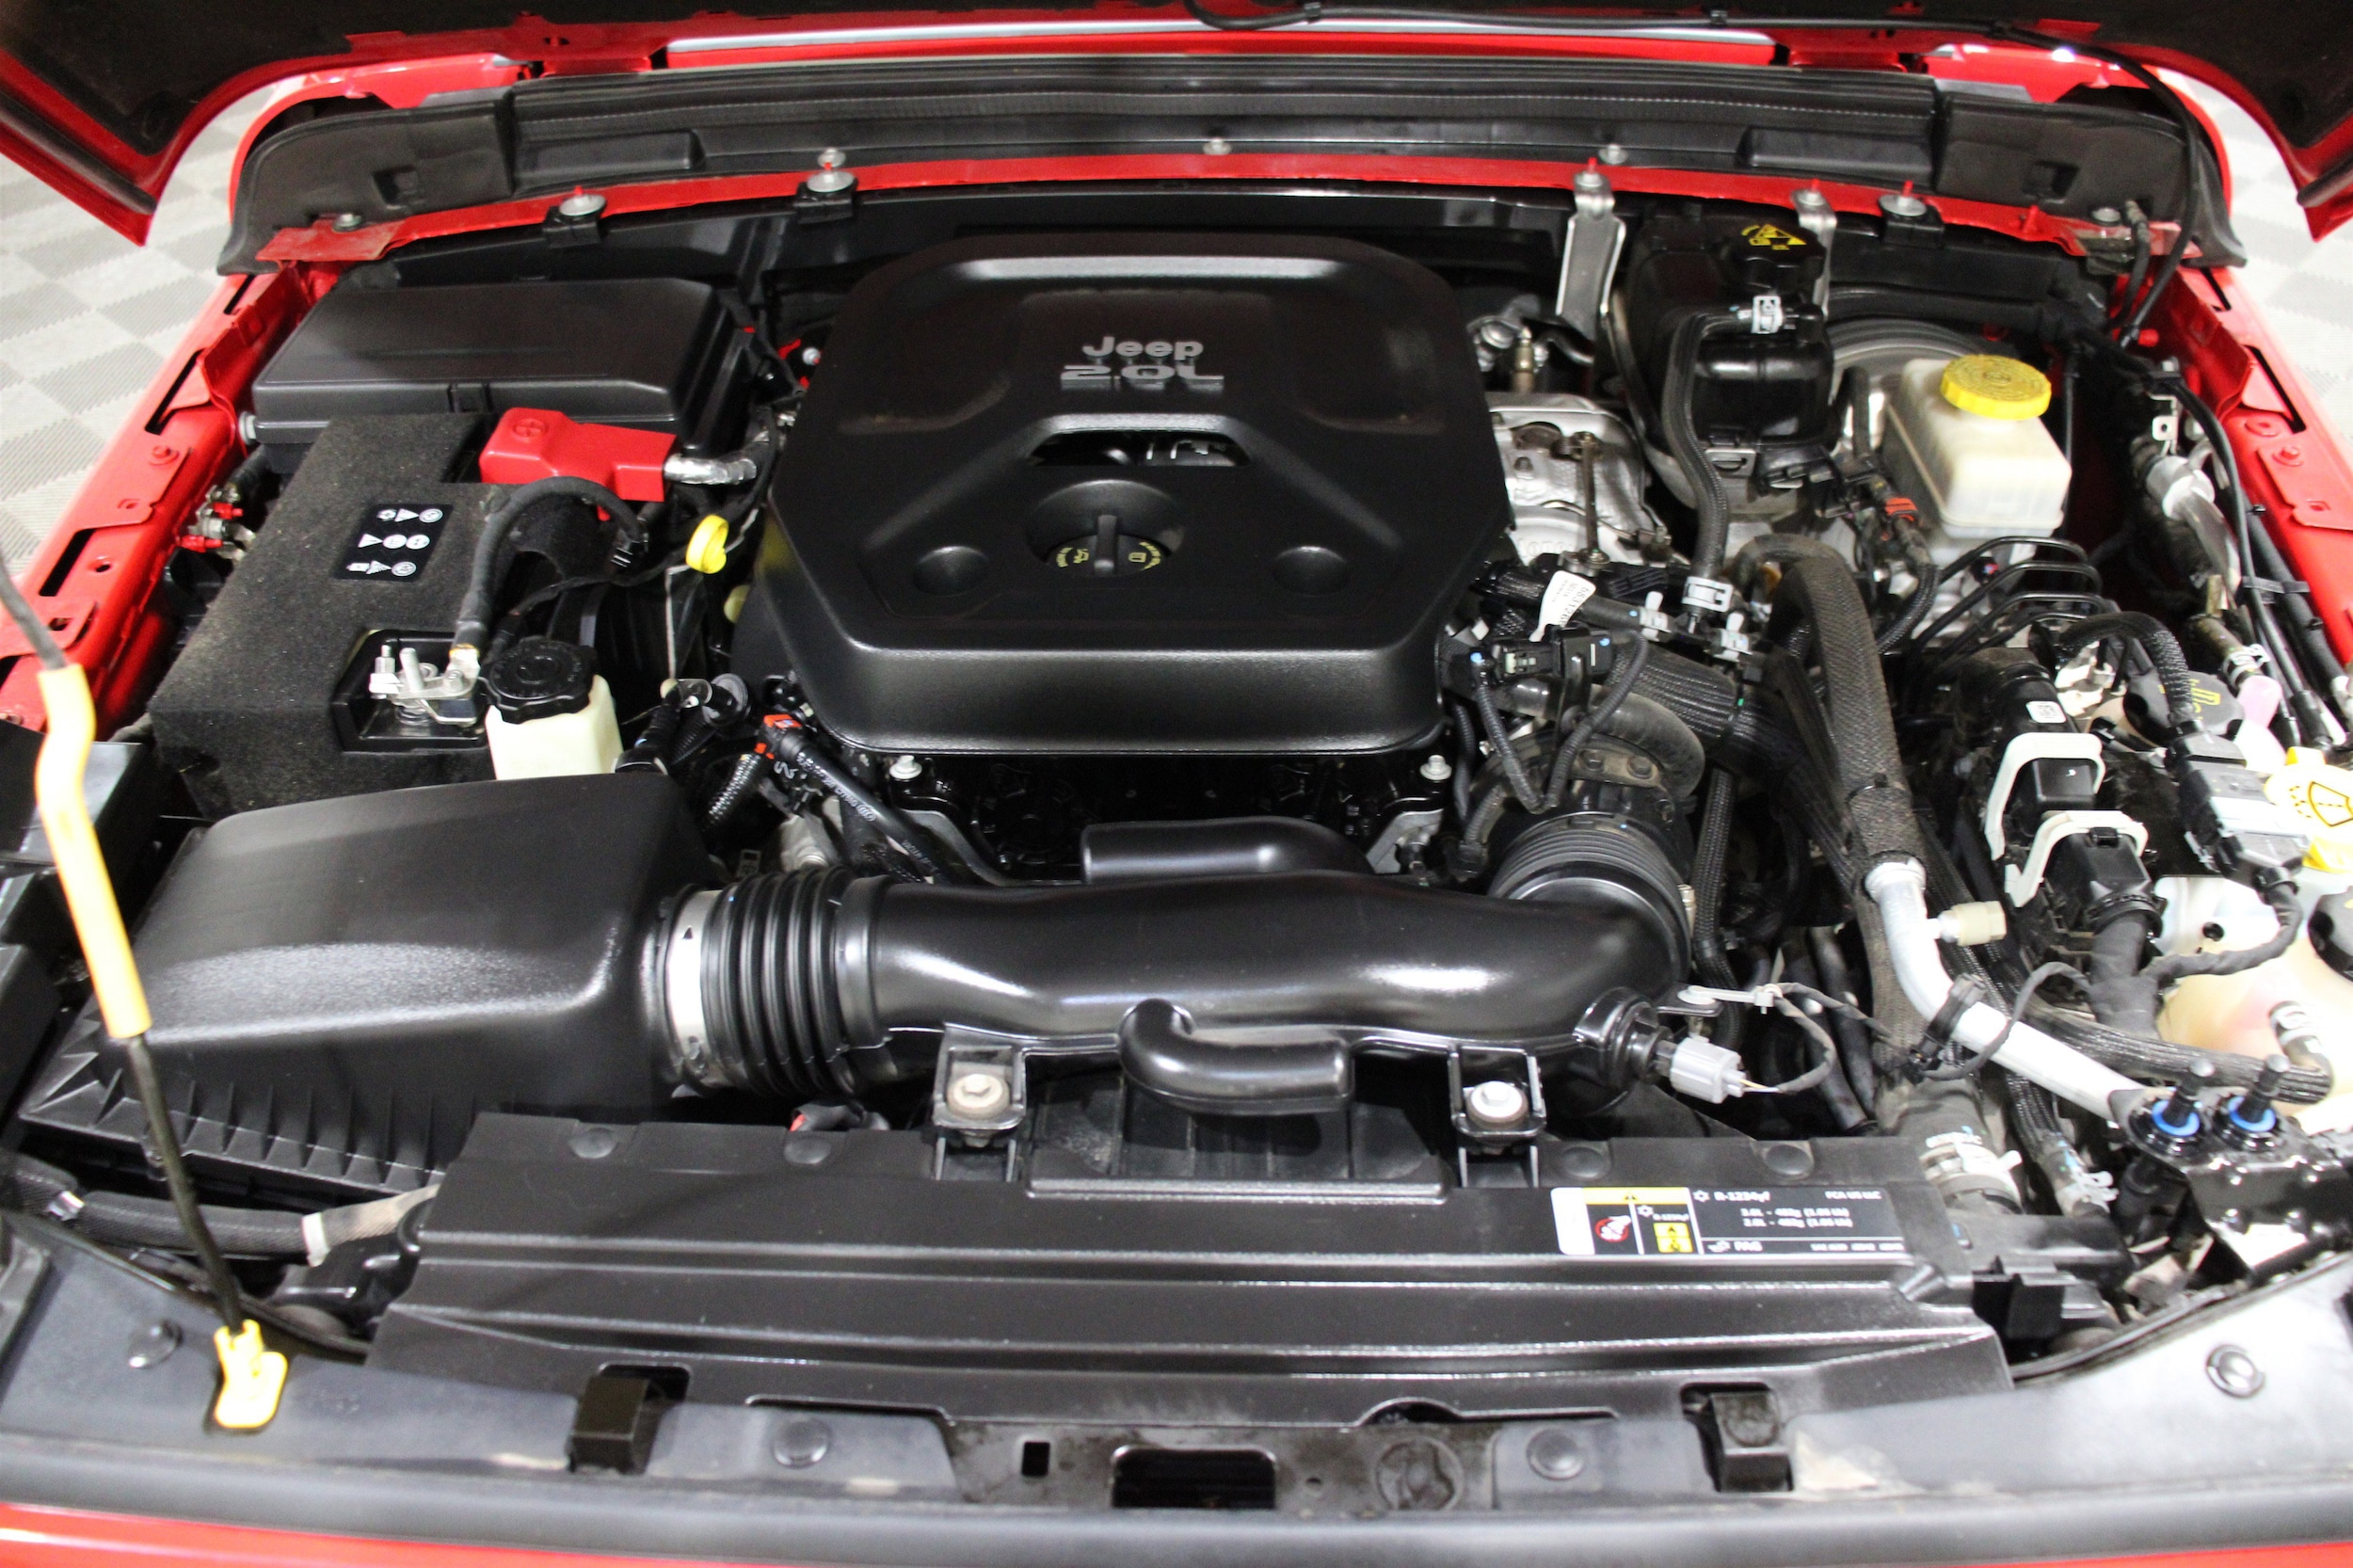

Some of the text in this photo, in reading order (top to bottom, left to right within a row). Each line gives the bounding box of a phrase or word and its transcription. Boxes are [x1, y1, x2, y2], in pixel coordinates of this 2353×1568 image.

[1082, 336, 1204, 360] Jeep
[1061, 365, 1225, 384] 2.0L
[1714, 1191, 1770, 1203] R-1234yf
